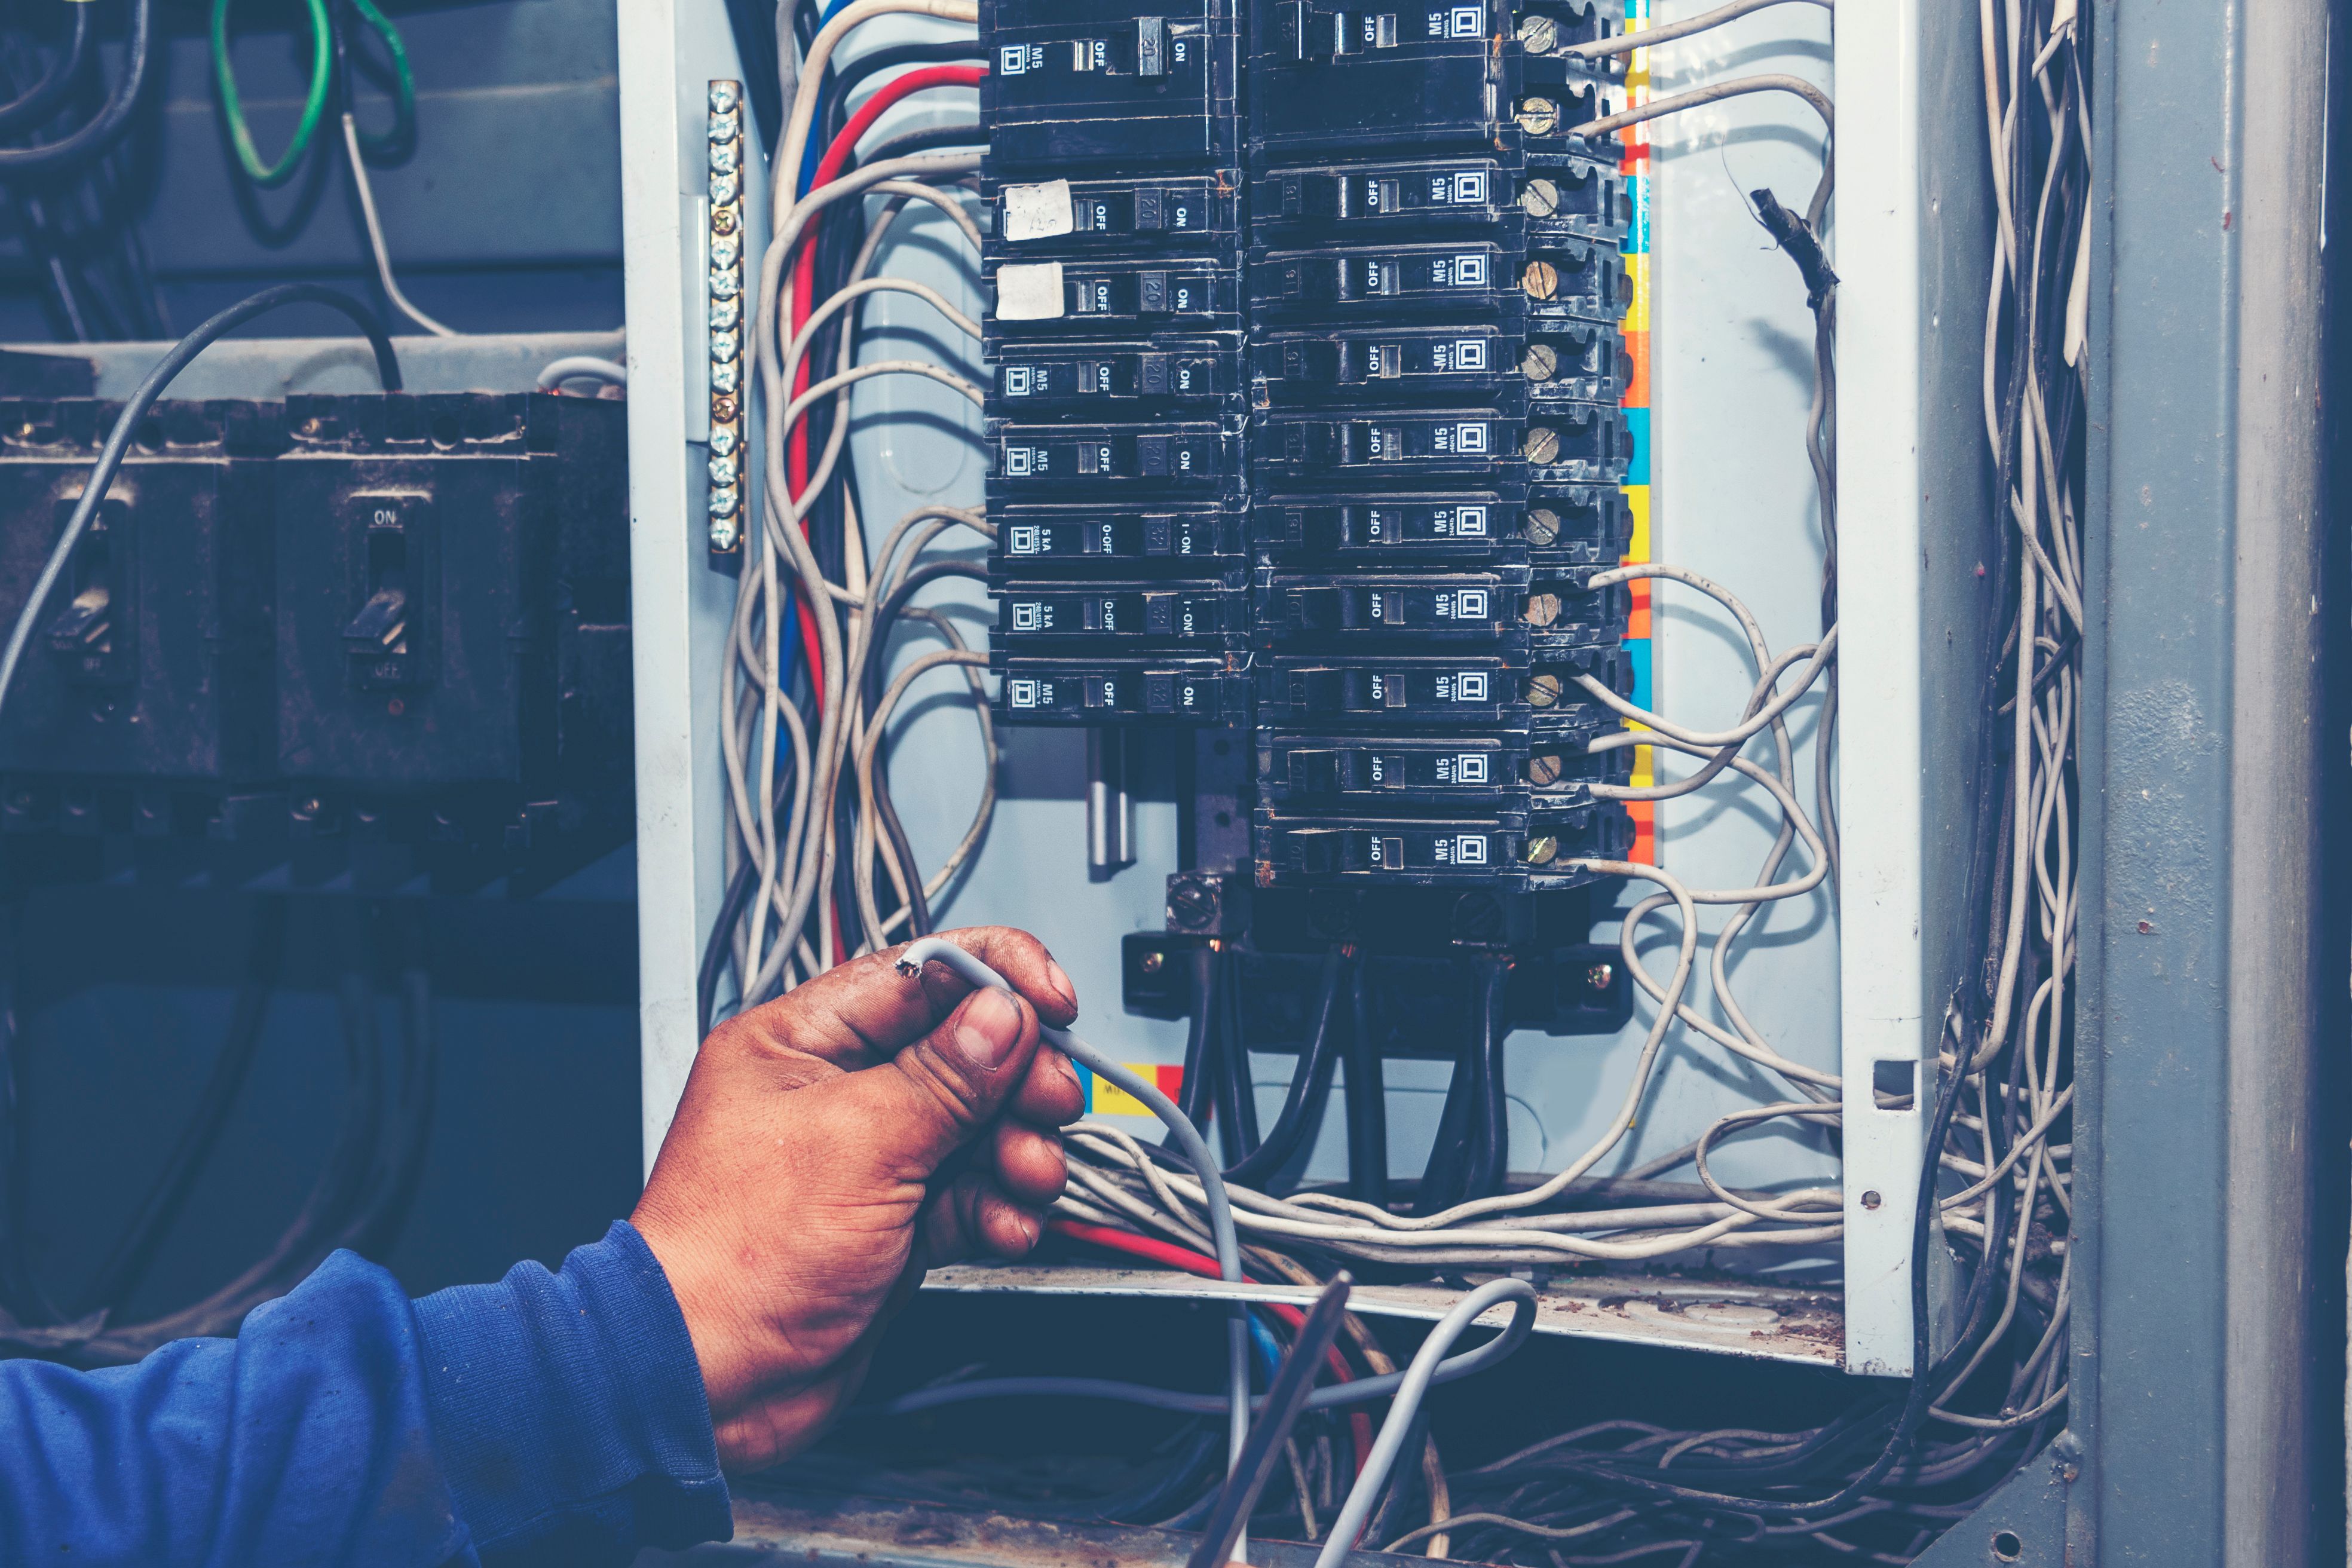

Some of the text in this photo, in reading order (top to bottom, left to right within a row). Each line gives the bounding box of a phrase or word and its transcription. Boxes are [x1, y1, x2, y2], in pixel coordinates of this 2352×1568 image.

[1364, 17, 1374, 42] OFF
[1428, 13, 1442, 35] M5
[1031, 47, 1043, 69] M5
[1095, 42, 1105, 66] OFF
[1175, 42, 1185, 62] ON
[1368, 180, 1378, 206] OFF
[1432, 178, 1446, 200] M5
[1096, 206, 1106, 230] OFF
[1176, 207, 1187, 227] ON
[1368, 262, 1379, 287] OFF
[1432, 260, 1446, 282] M5
[1097, 286, 1107, 311] OFF
[1177, 289, 1188, 308] ON
[1369, 346, 1379, 370] OFF
[1432, 344, 1447, 369] M5
[1037, 370, 1048, 391] M5
[1100, 367, 1109, 391] OFF
[1180, 369, 1190, 389] ON
[1370, 428, 1381, 453] OFF
[1434, 427, 1448, 449] M5
[1037, 451, 1048, 471] M5
[1100, 448, 1110, 471] OFF
[1180, 451, 1190, 470] ON
[374, 510, 396, 525] ON
[1370, 510, 1380, 535] OFF
[1434, 511, 1447, 532] M5
[1042, 538, 1051, 552] kA
[1371, 593, 1382, 618] OFF
[1435, 594, 1449, 615] M5
[1044, 614, 1053, 628] kA
[1042, 684, 1053, 704] M5
[1104, 682, 1114, 706] OFF
[1183, 687, 1194, 706] ON
[1372, 675, 1382, 699] OFF
[1436, 676, 1449, 697] M5
[1373, 757, 1382, 781] OFF
[1436, 758, 1449, 779] M5
[1371, 836, 1381, 860] OFF
[1435, 839, 1448, 860] M5
